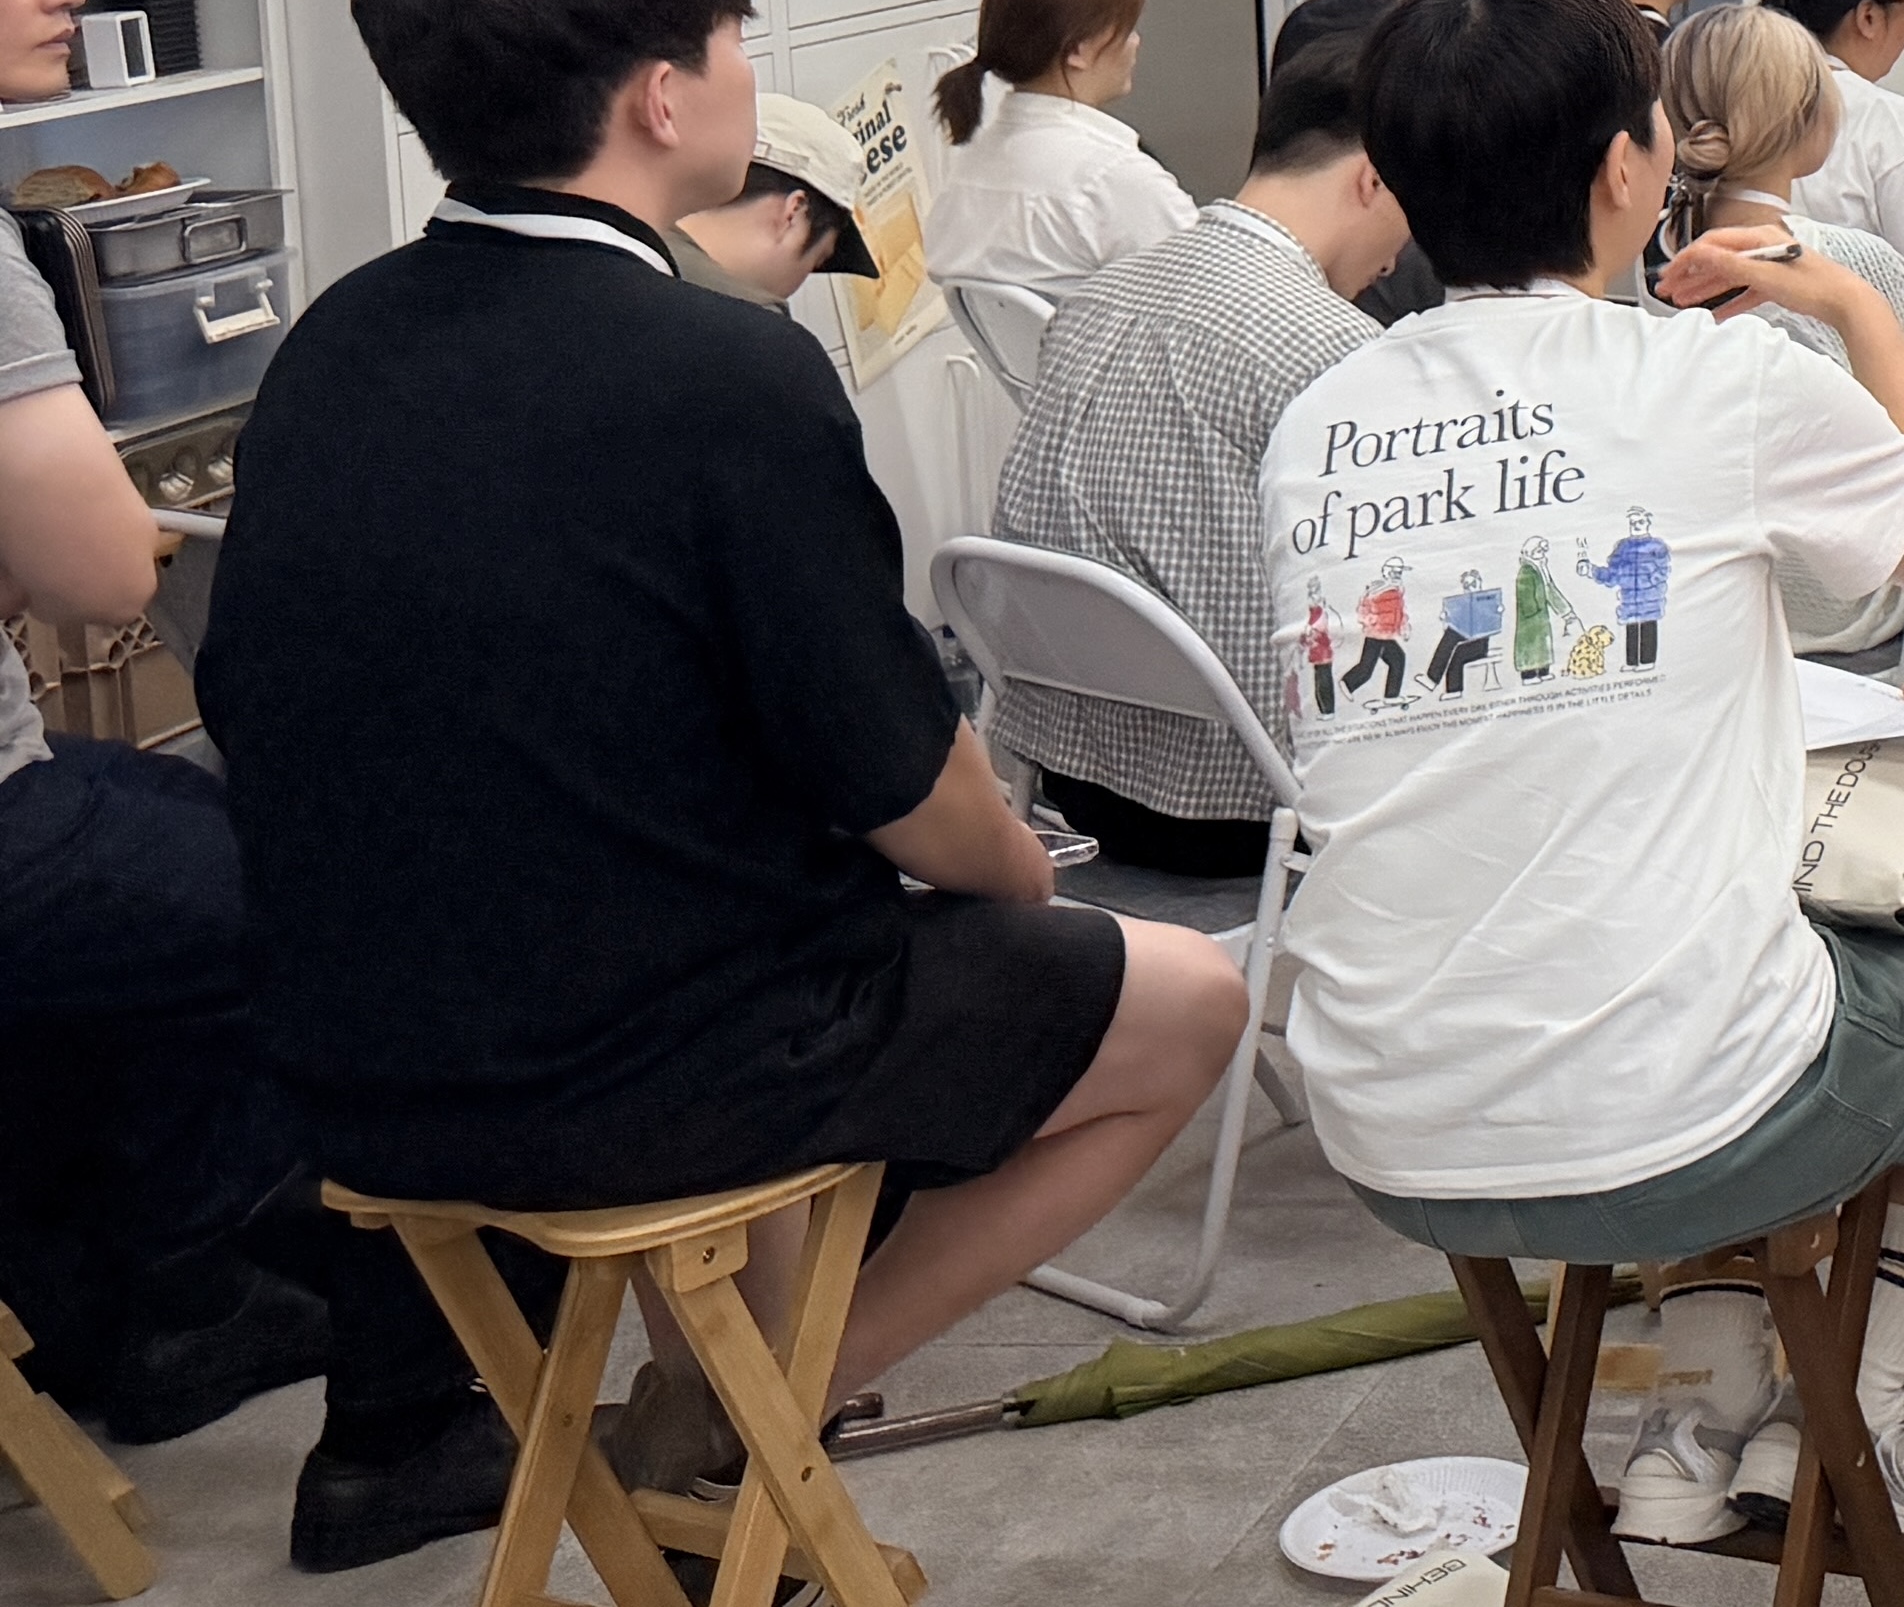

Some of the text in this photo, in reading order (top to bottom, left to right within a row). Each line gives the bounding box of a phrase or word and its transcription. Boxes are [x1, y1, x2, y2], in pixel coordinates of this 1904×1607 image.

[1318, 389, 1555, 478] Portraits
[1292, 449, 1586, 560] of park life
[1810, 788, 1851, 834] THE
